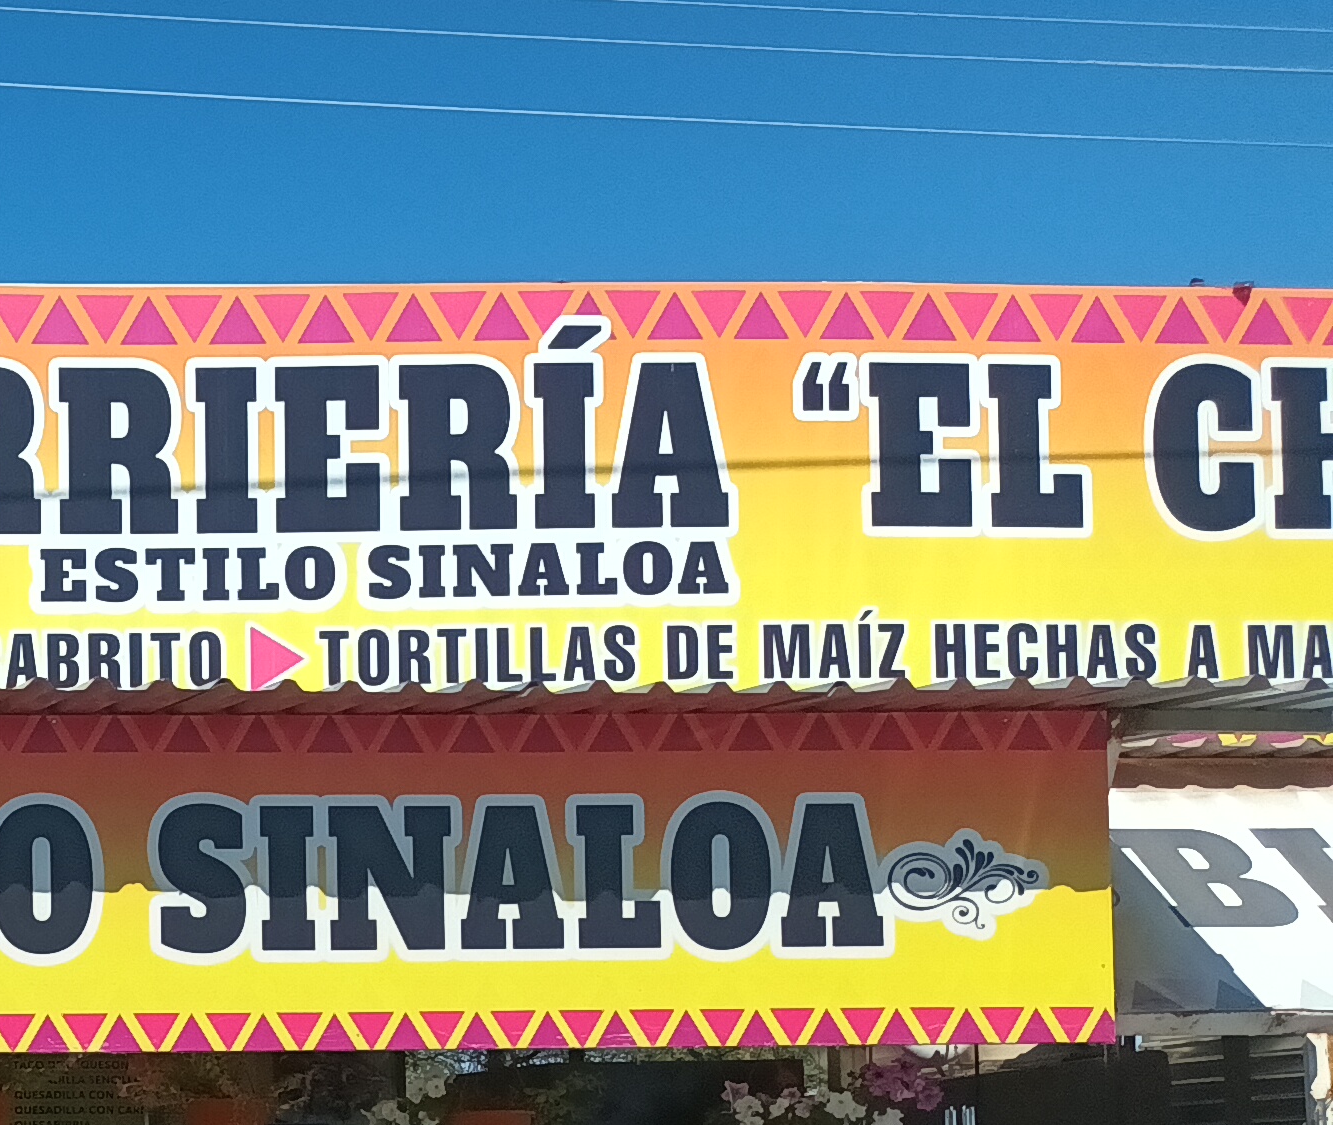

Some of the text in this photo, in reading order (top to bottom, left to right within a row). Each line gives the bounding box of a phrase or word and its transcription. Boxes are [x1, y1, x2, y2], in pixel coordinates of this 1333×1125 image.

[800, 360, 1086, 529] “EL
[38, 540, 730, 604] ESTILO SINALOA
[319, 609, 1333, 685] TORTILLAS DE MAÍZ HECHAS A MA
[155, 800, 886, 955] SINALOA
[13, 1090, 86, 1100] QUESADILLA
[88, 1090, 115, 1100] CON
[14, 1105, 86, 1115] QUESADILLA
[88, 1105, 115, 1115] CON
